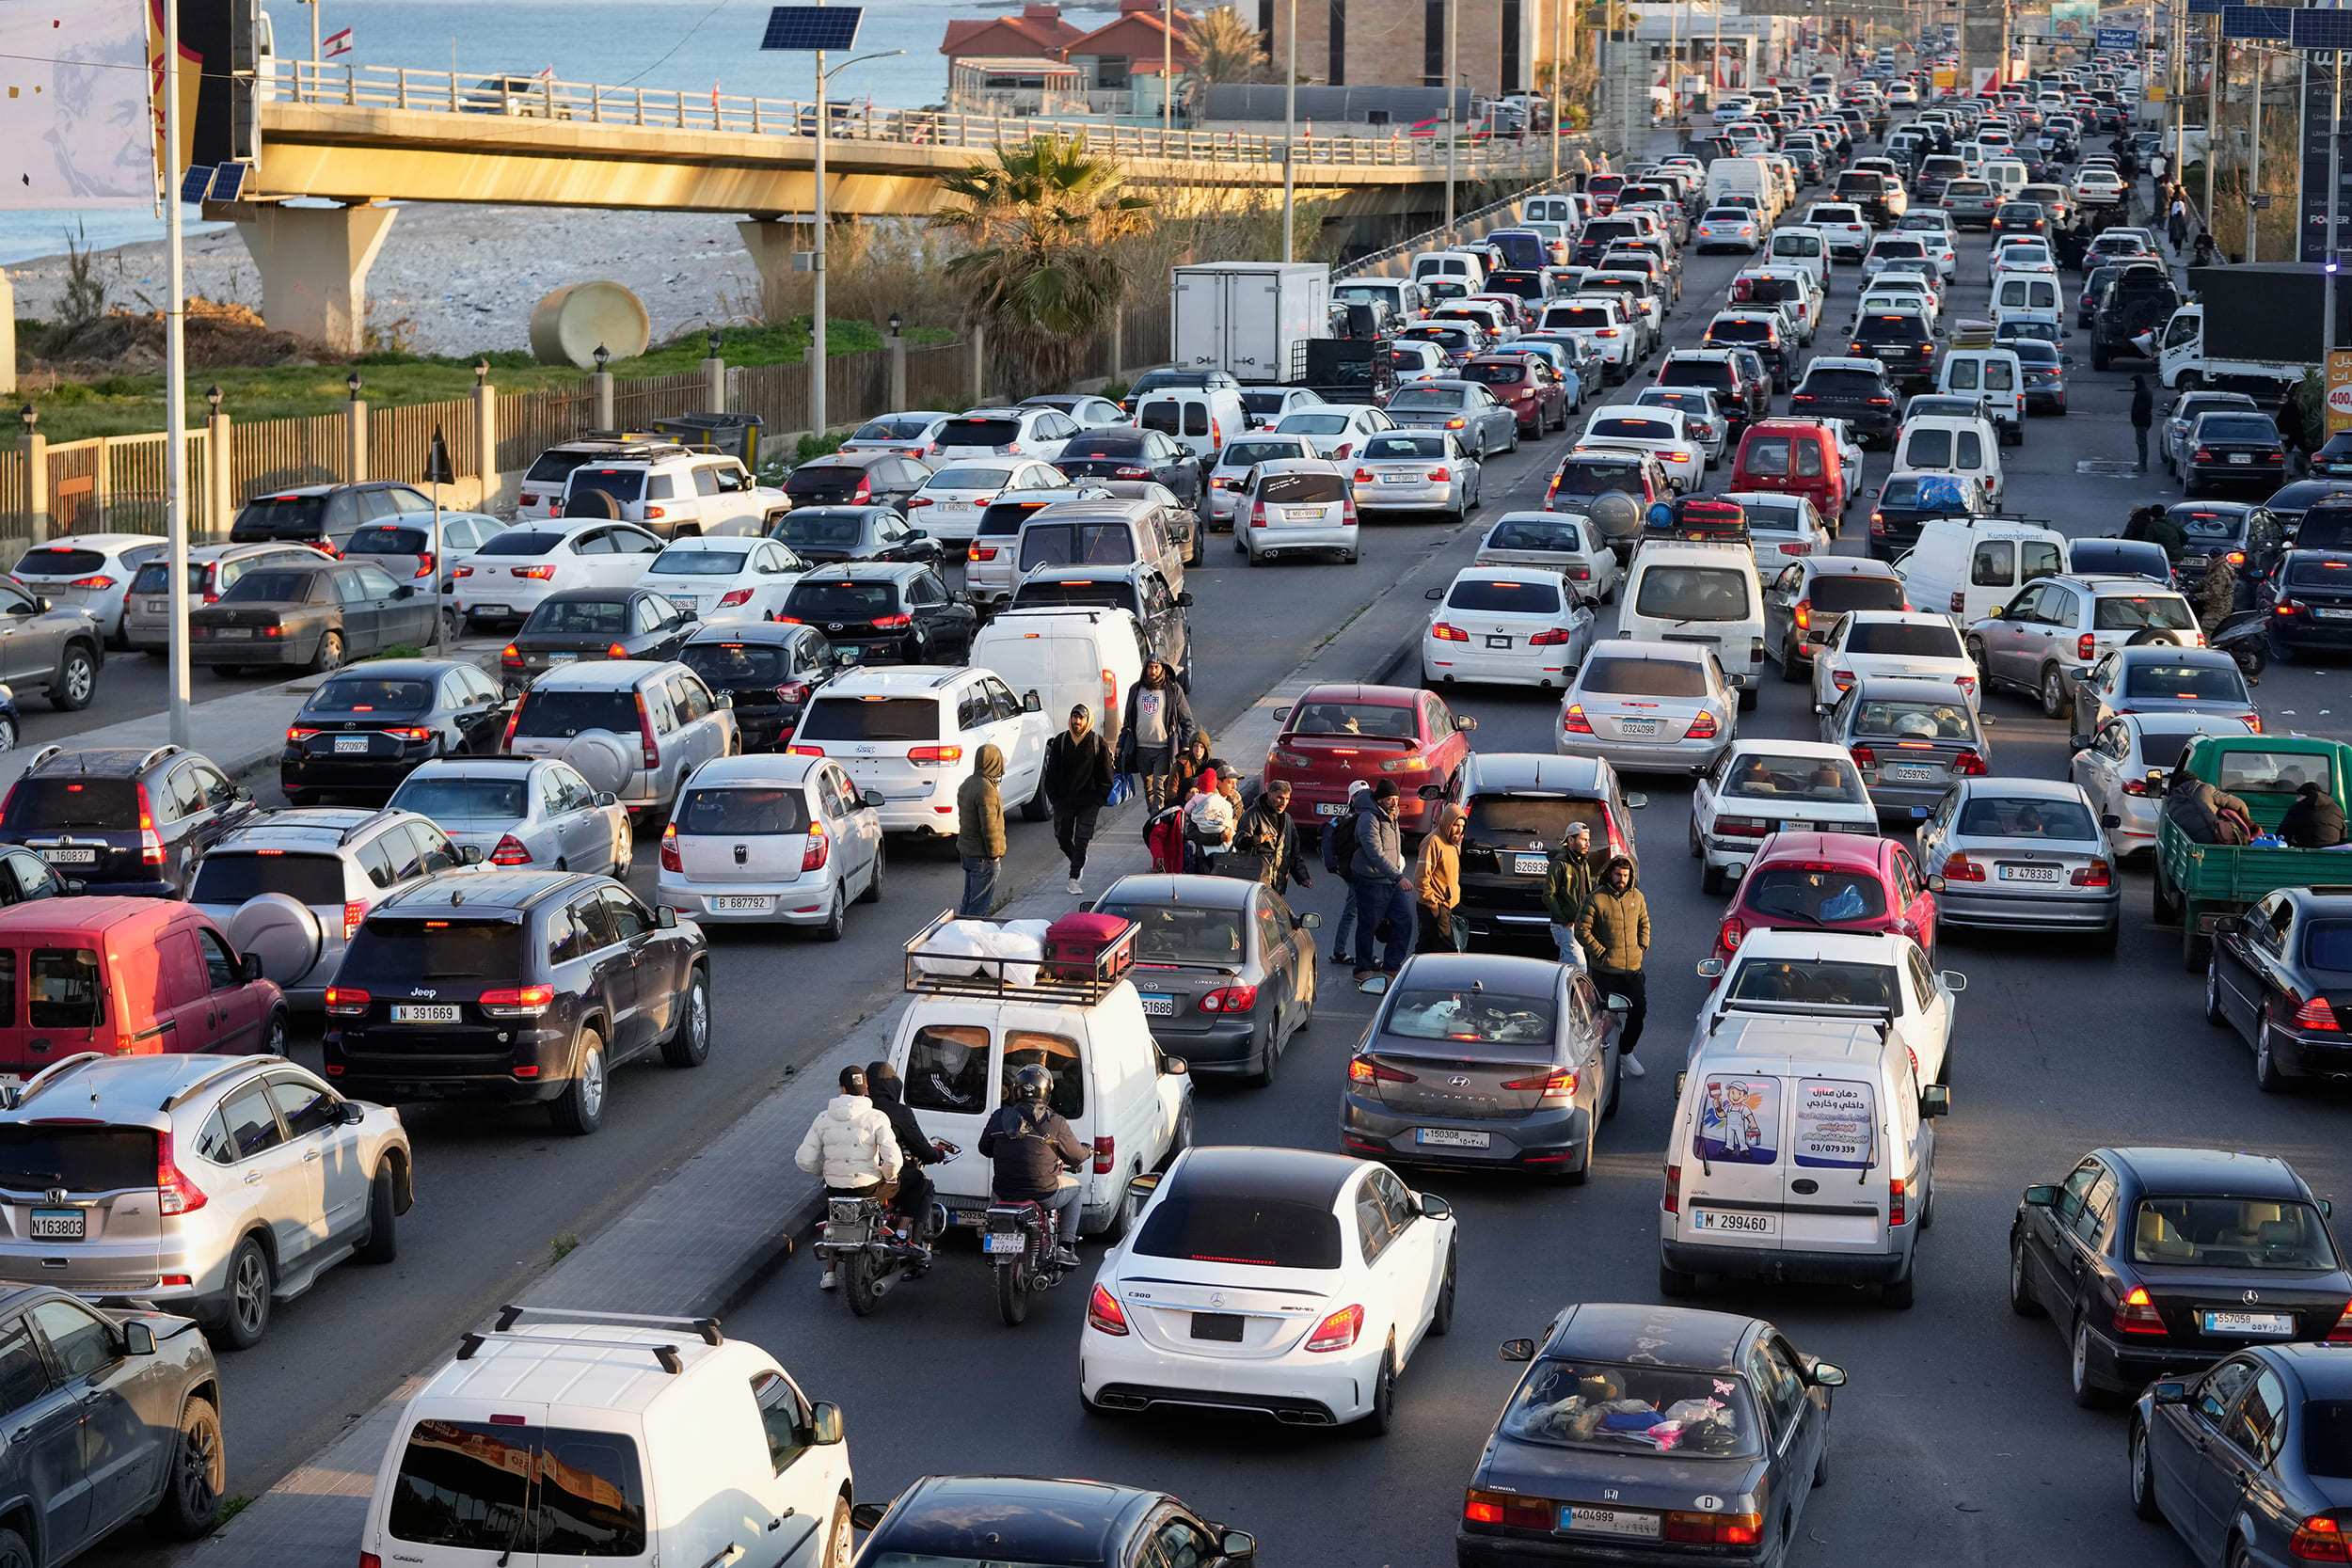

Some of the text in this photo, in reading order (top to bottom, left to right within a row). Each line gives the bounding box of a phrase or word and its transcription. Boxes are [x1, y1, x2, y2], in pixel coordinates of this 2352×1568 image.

[2310, 214, 2349, 225] POER
[2329, 420, 2349, 430] CAR
[1987, 531, 2043, 541] Kundendienst
[1143, 703, 1158, 713] NFL
[856, 745, 877, 754] Jeep
[1323, 804, 1349, 816] G 527
[44, 850, 89, 862] N 160837
[1516, 861, 1549, 874] S26936
[2008, 867, 2053, 880] B 478338
[720, 897, 765, 909] B 687792
[411, 987, 437, 999] Jeep
[400, 1007, 453, 1020] N 391669
[1142, 1000, 1173, 1015] 51686
[1812, 1088, 1858, 1100] دهان منازل
[1806, 1099, 1865, 1110] داخلي وخارجي
[1841, 1144, 1856, 1153] 339
[33, 1220, 84, 1234] N163803
[1705, 1214, 1767, 1231] M 299460
[1128, 1291, 1152, 1299] C300
[1489, 1484, 1517, 1493] HONDA
[1705, 1497, 1713, 1509] D
